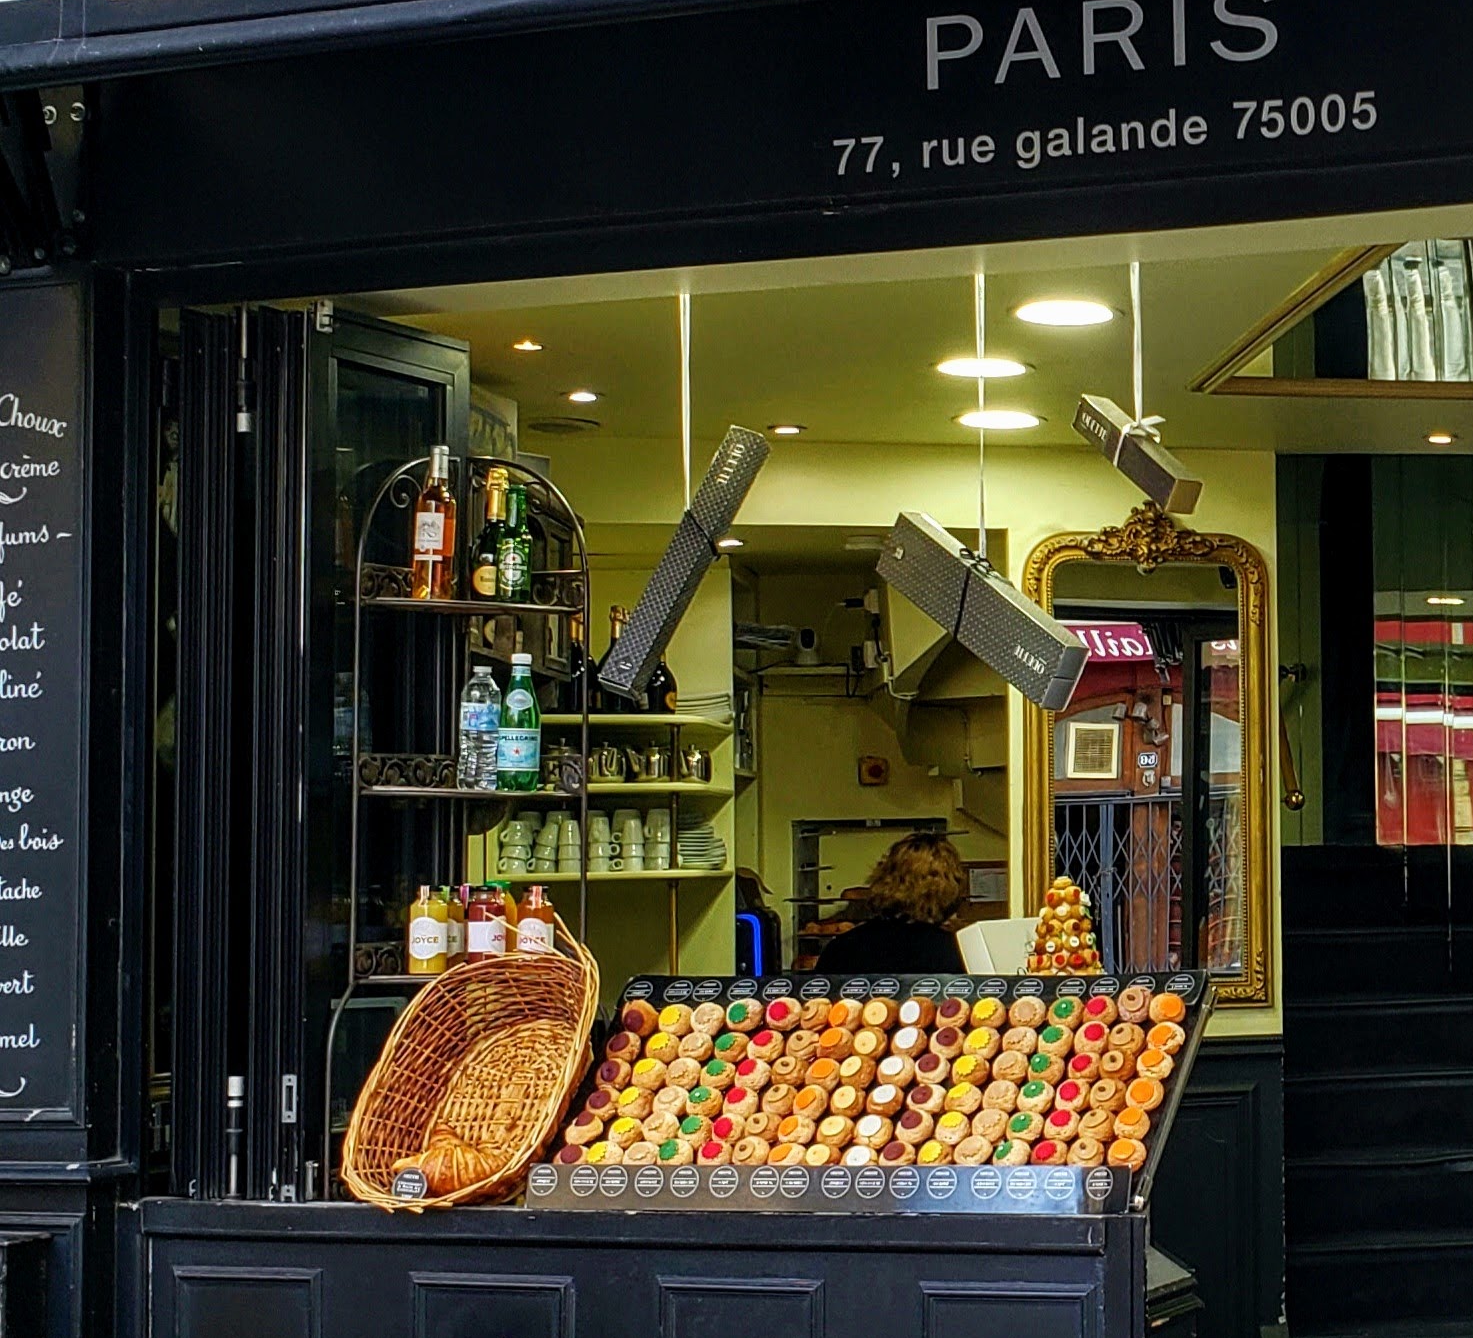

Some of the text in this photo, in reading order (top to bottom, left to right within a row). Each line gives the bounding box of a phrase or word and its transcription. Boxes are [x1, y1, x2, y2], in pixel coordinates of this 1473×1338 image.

[834, 91, 1376, 177] 77, rue galande 75005
[18, 823, 63, 850] bois
